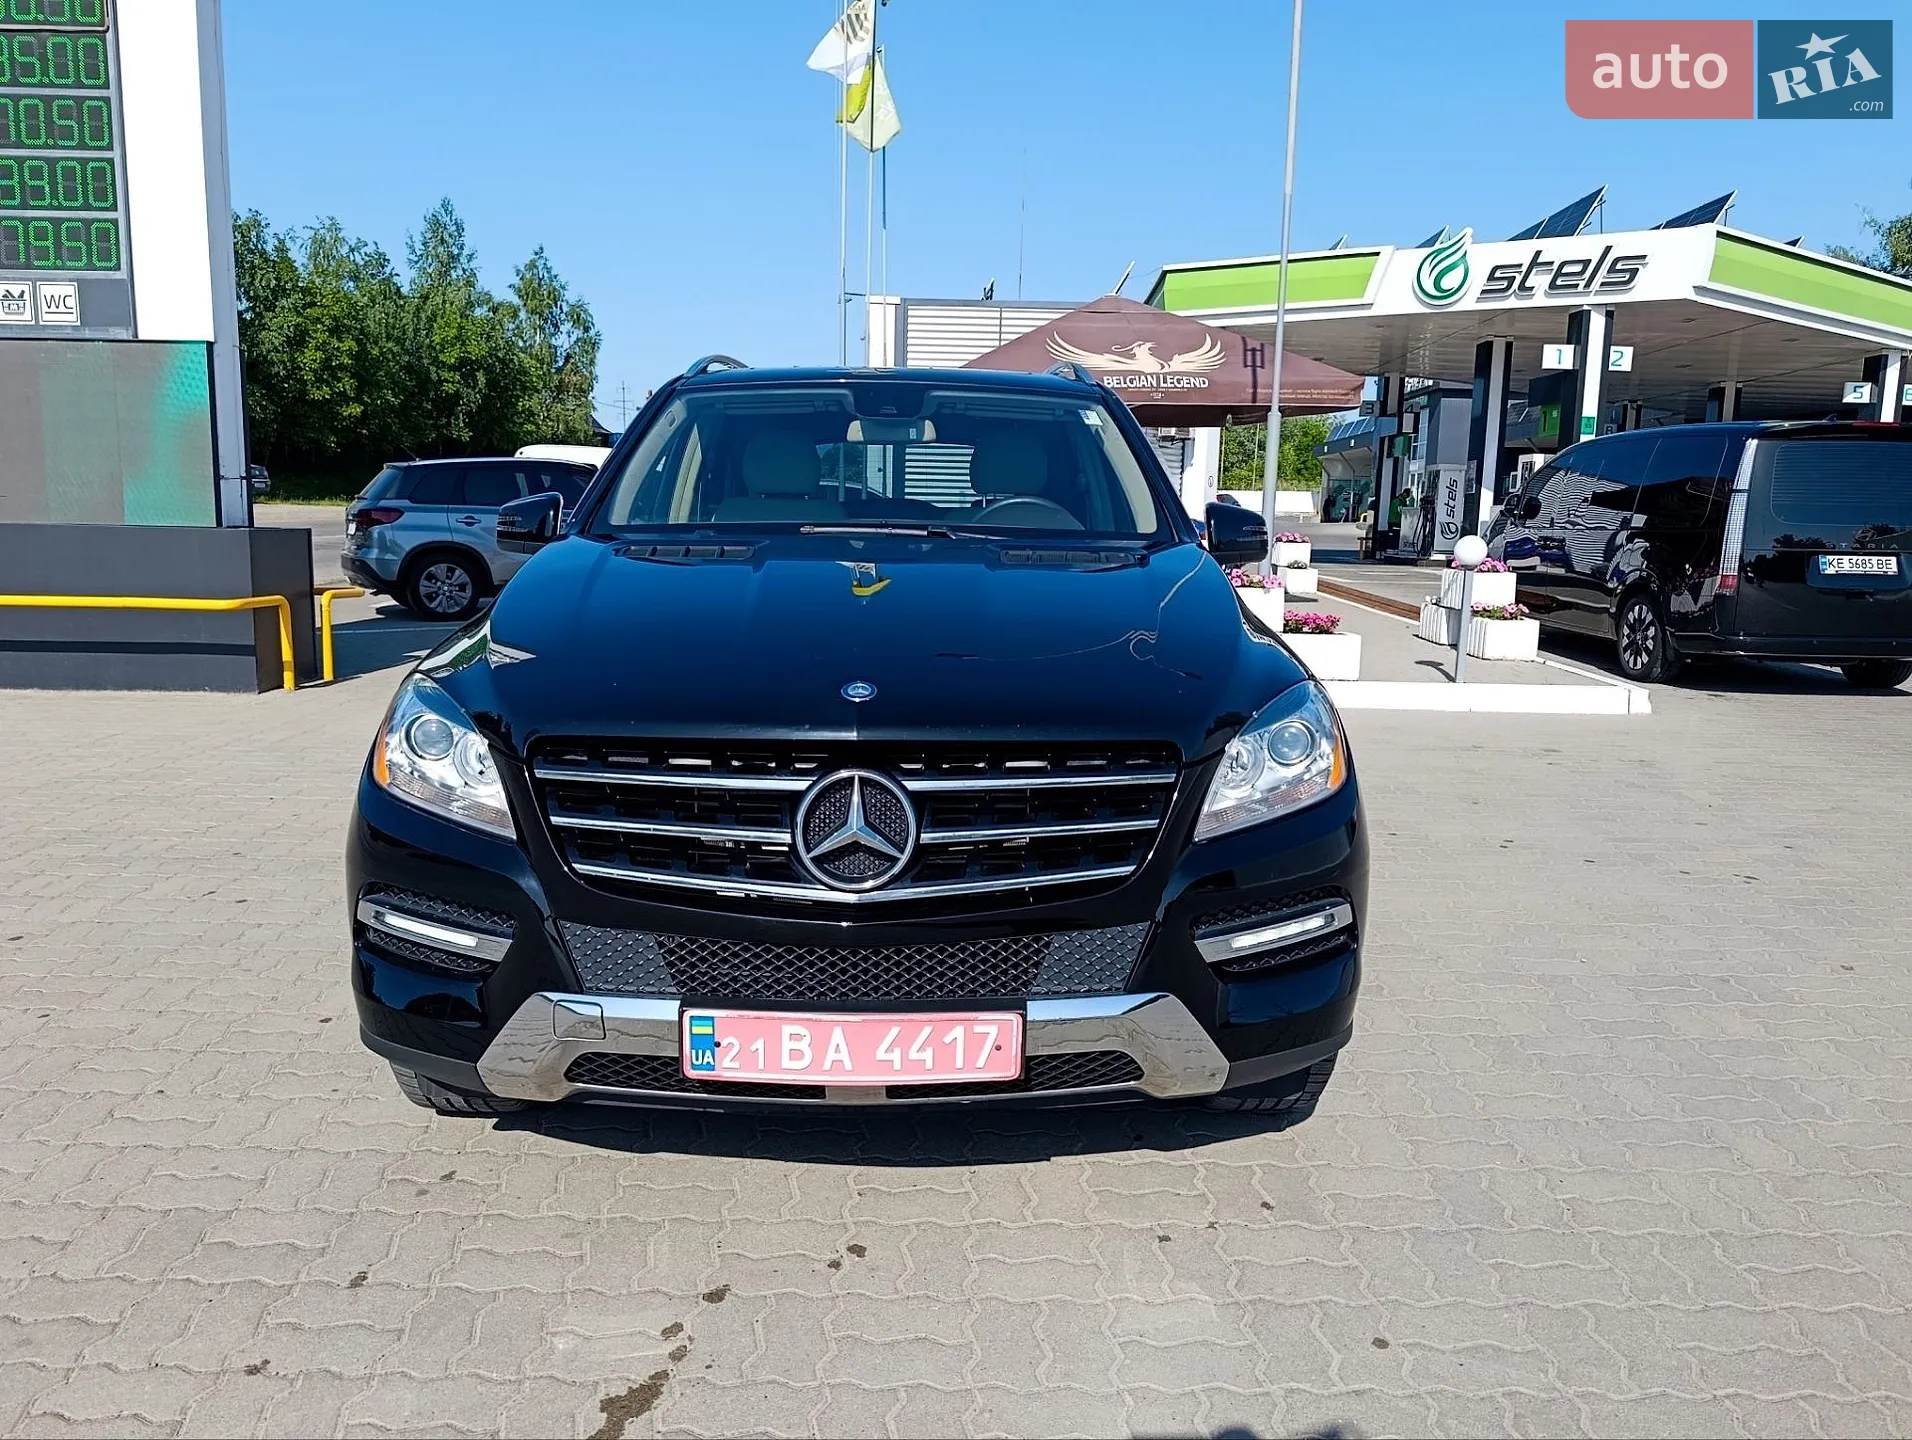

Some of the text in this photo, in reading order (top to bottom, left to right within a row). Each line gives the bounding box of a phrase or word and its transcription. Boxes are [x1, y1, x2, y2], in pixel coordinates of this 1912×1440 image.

[1, 220, 117, 267] 79.50
[1480, 245, 1648, 298] stels
[43, 294, 74, 309] WC
[1556, 349, 1562, 365] 1
[1611, 350, 1624, 366] 2
[1103, 374, 1209, 388] BELGIAN LEGEND
[1853, 386, 1863, 399] 5
[1365, 403, 1374, 414] 3
[1444, 477, 1458, 519] stels
[1828, 558, 1893, 570] KE 5685 BE
[721, 1024, 999, 1071] 21 BA 4417
[692, 1049, 715, 1065] UA
